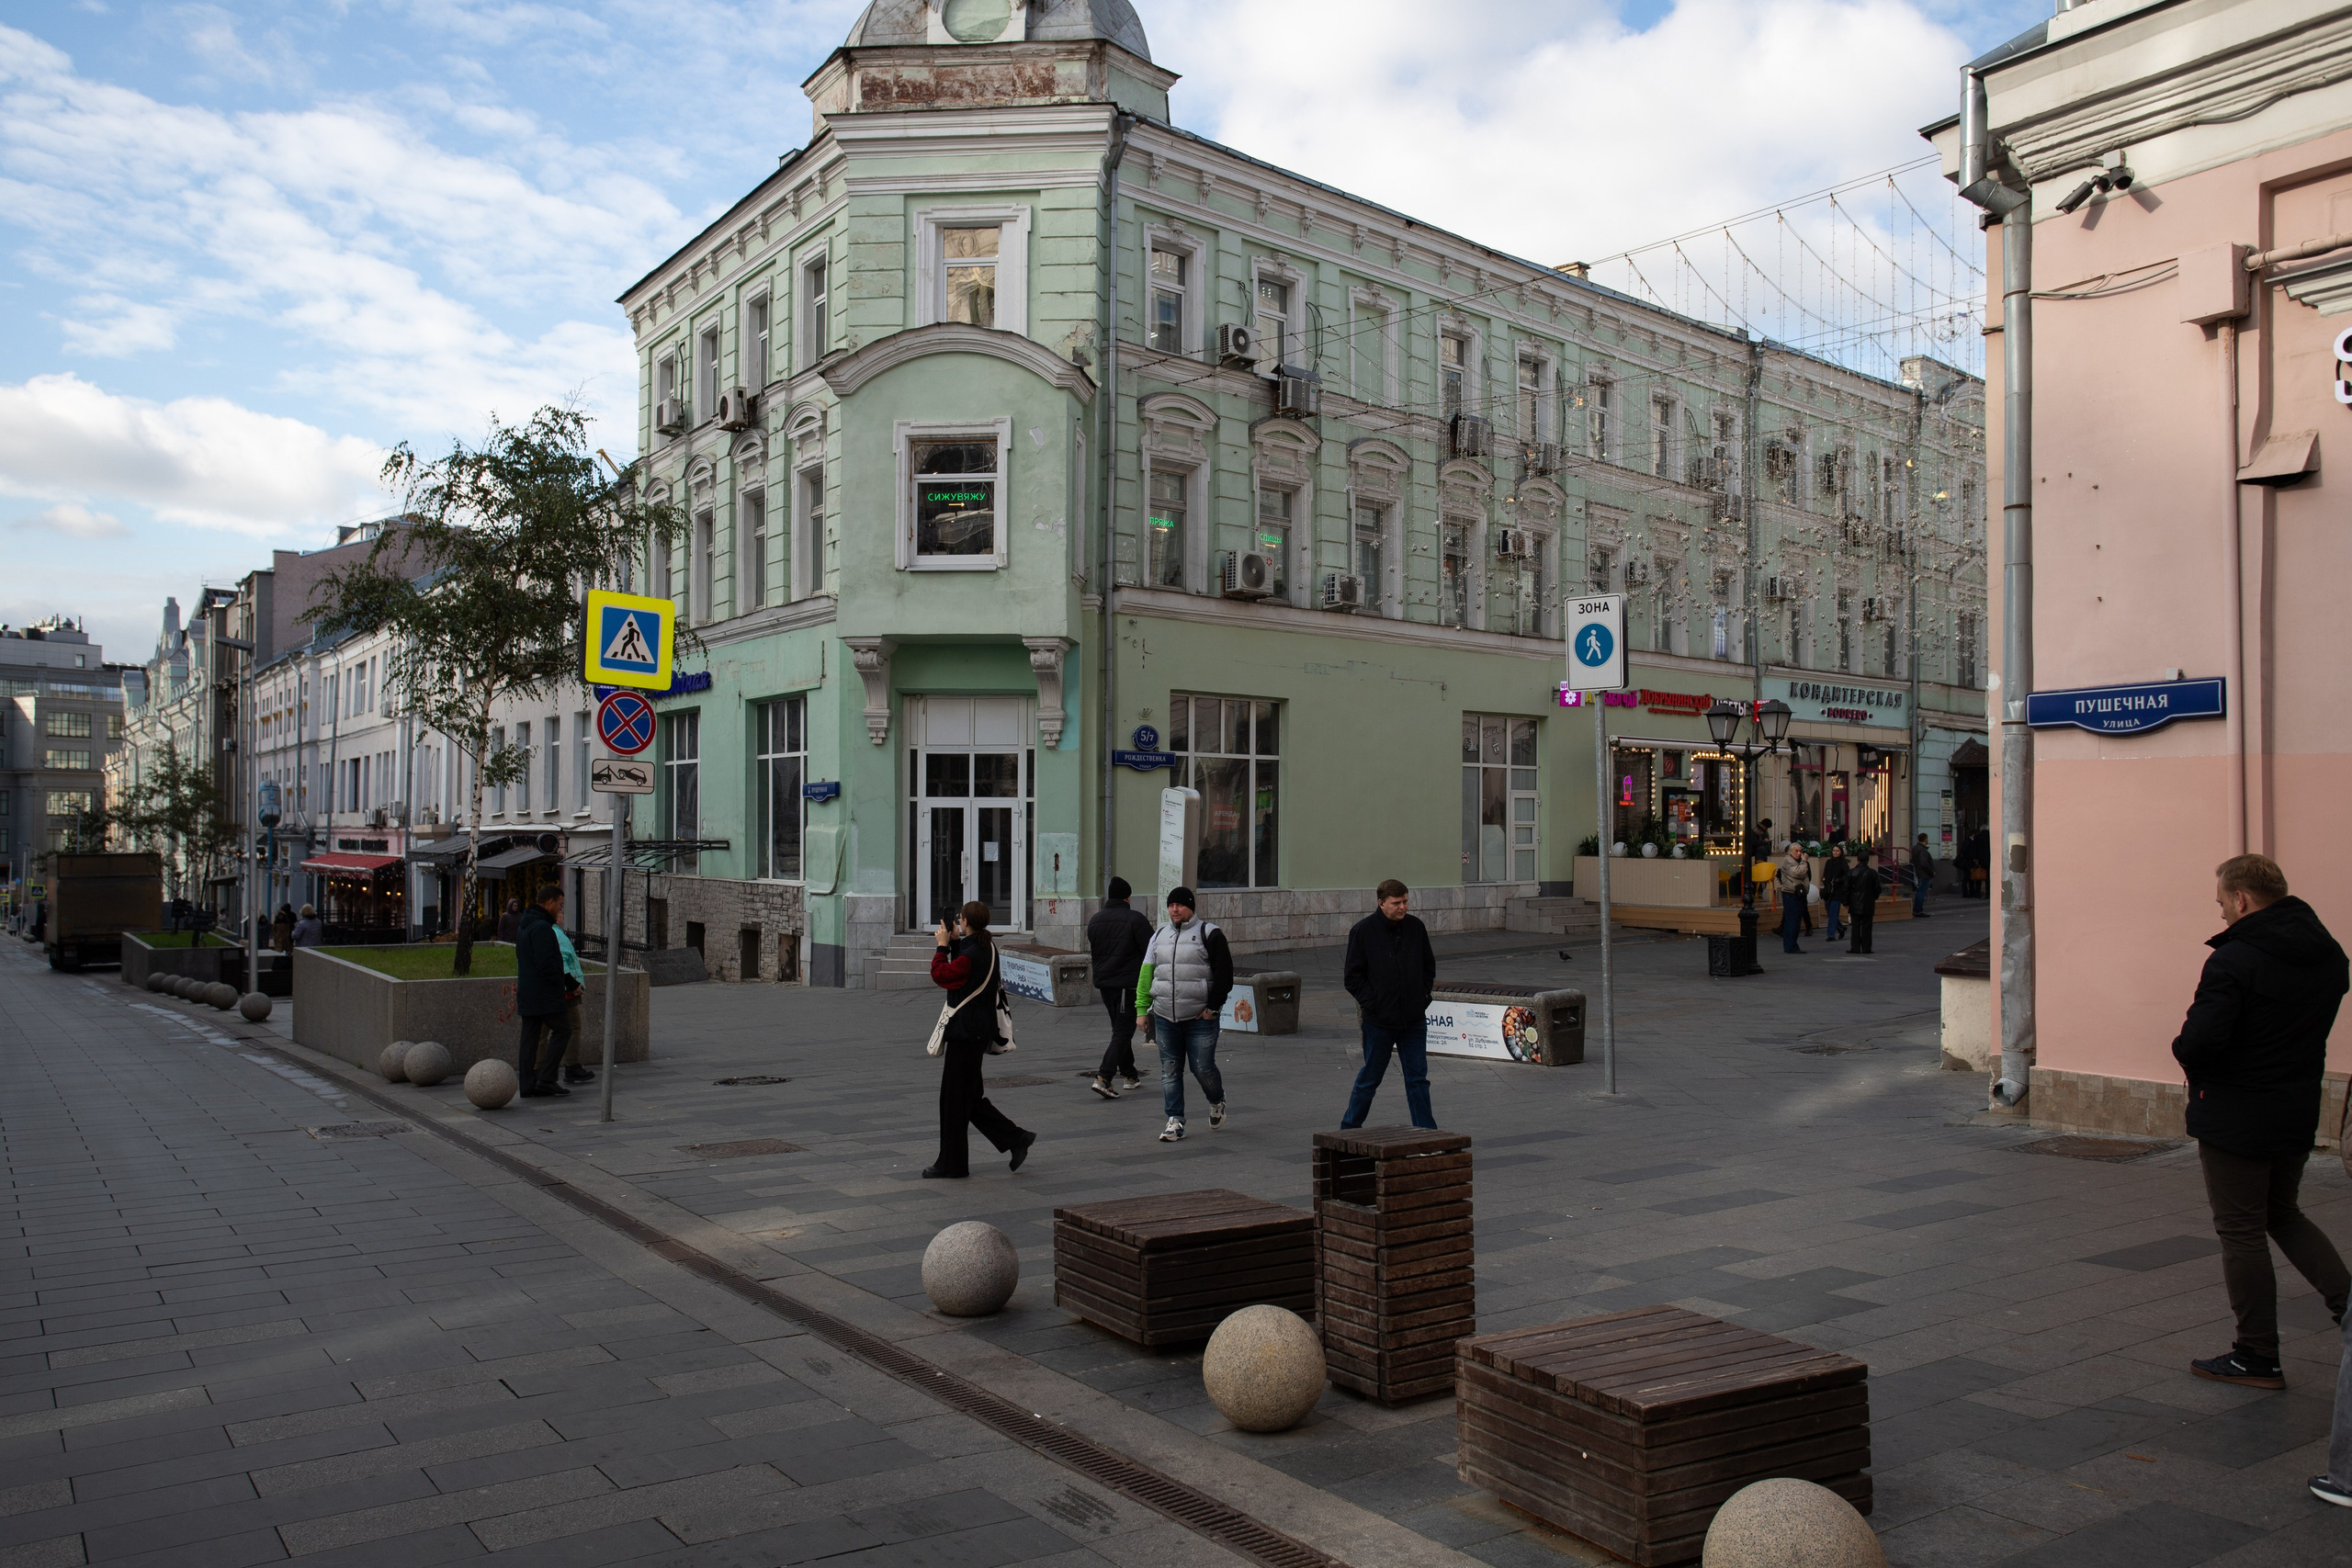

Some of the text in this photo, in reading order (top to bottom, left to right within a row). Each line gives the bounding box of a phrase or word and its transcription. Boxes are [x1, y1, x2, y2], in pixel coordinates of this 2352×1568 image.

[927, 492, 986, 502] СИЖУВЯЖУ
[1149, 516, 1175, 527] ПРЯЖА
[1259, 533, 1283, 544] СПИЦЫ
[1578, 602, 1610, 615] ЗОНА
[1604, 691, 1637, 707] БАБЛ ЧАЙ
[1639, 689, 1712, 711] ДОБРЫНИНСКИЙ
[1790, 682, 1902, 707] КОНДИТЕРСКАЯ
[2075, 694, 2168, 714] ПУШЕЧНАЯ
[2103, 718, 2141, 728] УЛИЦА
[1140, 730, 1154, 742] 5/7
[1125, 754, 1166, 762] РОЖДЕСТВЕНКА
